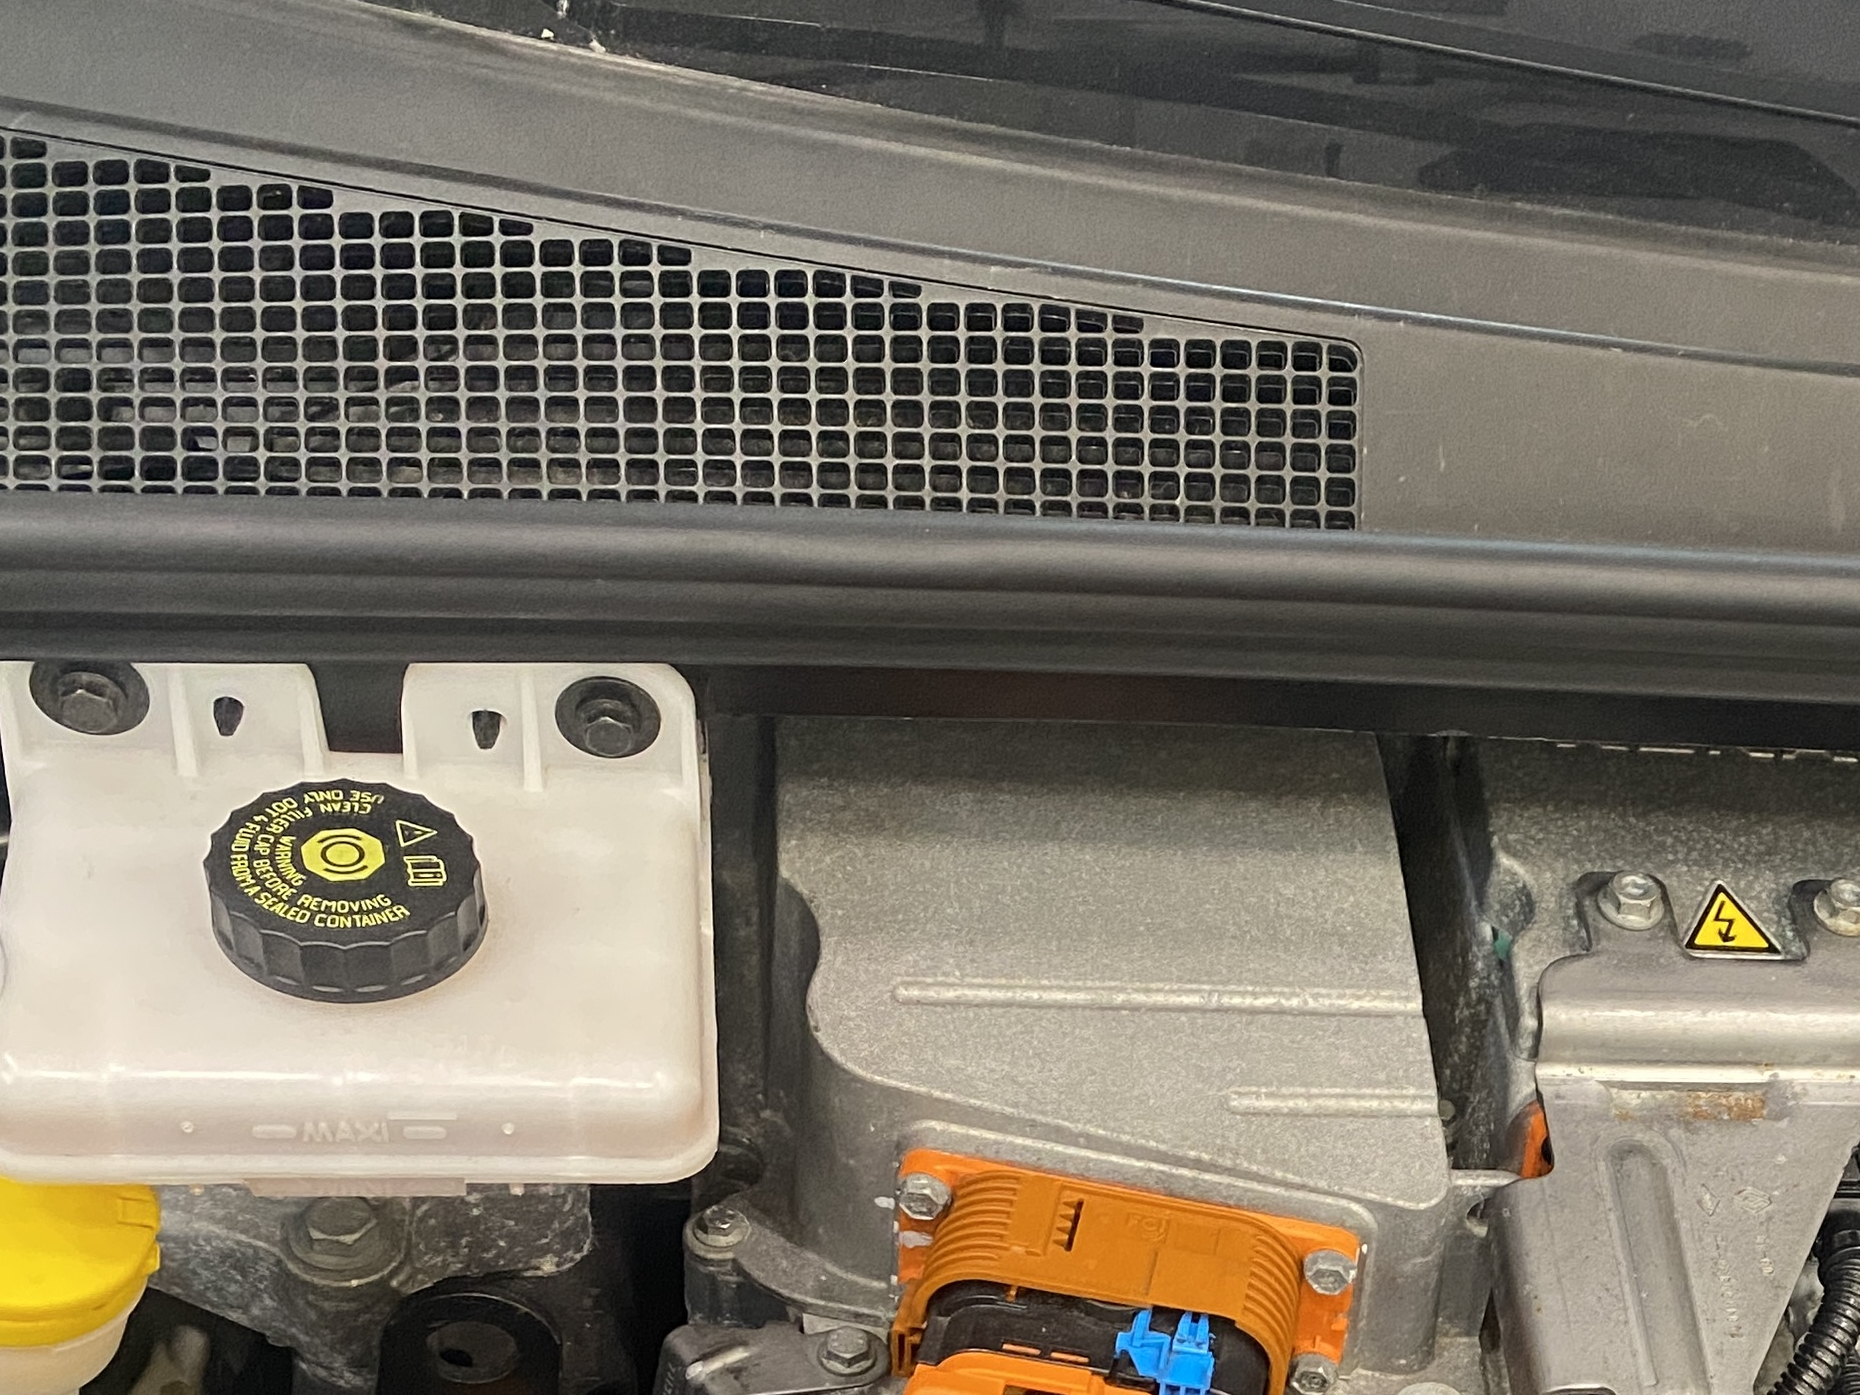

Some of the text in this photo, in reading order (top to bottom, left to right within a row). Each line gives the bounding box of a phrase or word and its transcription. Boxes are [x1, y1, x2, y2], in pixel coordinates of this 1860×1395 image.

[265, 797, 298, 817] DOT
[303, 789, 344, 804] ONLY
[350, 789, 384, 804] USE
[231, 822, 261, 852] FLUID
[253, 801, 392, 913] CLEAN FILLER CAP BEFORE REMOVING
[275, 835, 307, 886] WARNING
[230, 853, 256, 887] FROM
[243, 885, 261, 896] A
[254, 892, 311, 924] SEALED
[313, 905, 411, 928] CONTAINER
[302, 1121, 390, 1143] MAXI
